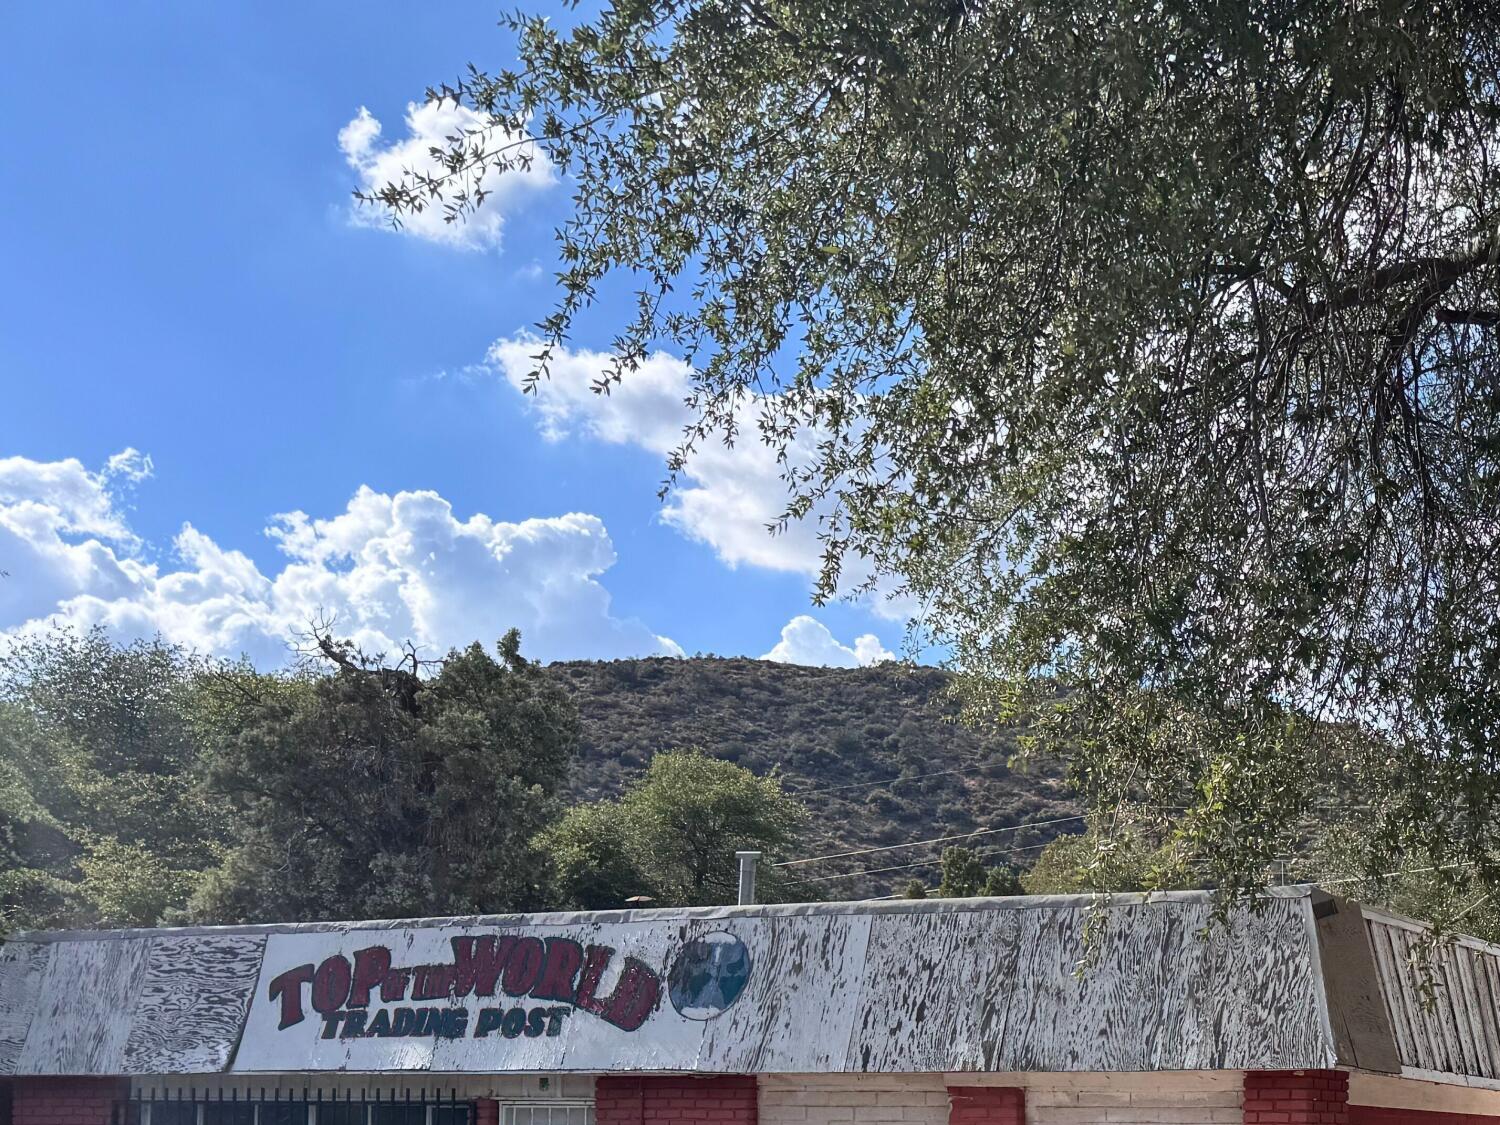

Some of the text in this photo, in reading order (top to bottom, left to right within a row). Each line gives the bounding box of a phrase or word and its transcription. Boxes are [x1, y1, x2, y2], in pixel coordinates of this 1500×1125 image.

[268, 945, 393, 1031] TOP
[450, 934, 661, 1032] WORLD
[320, 1006, 572, 1039] TRADING POST
